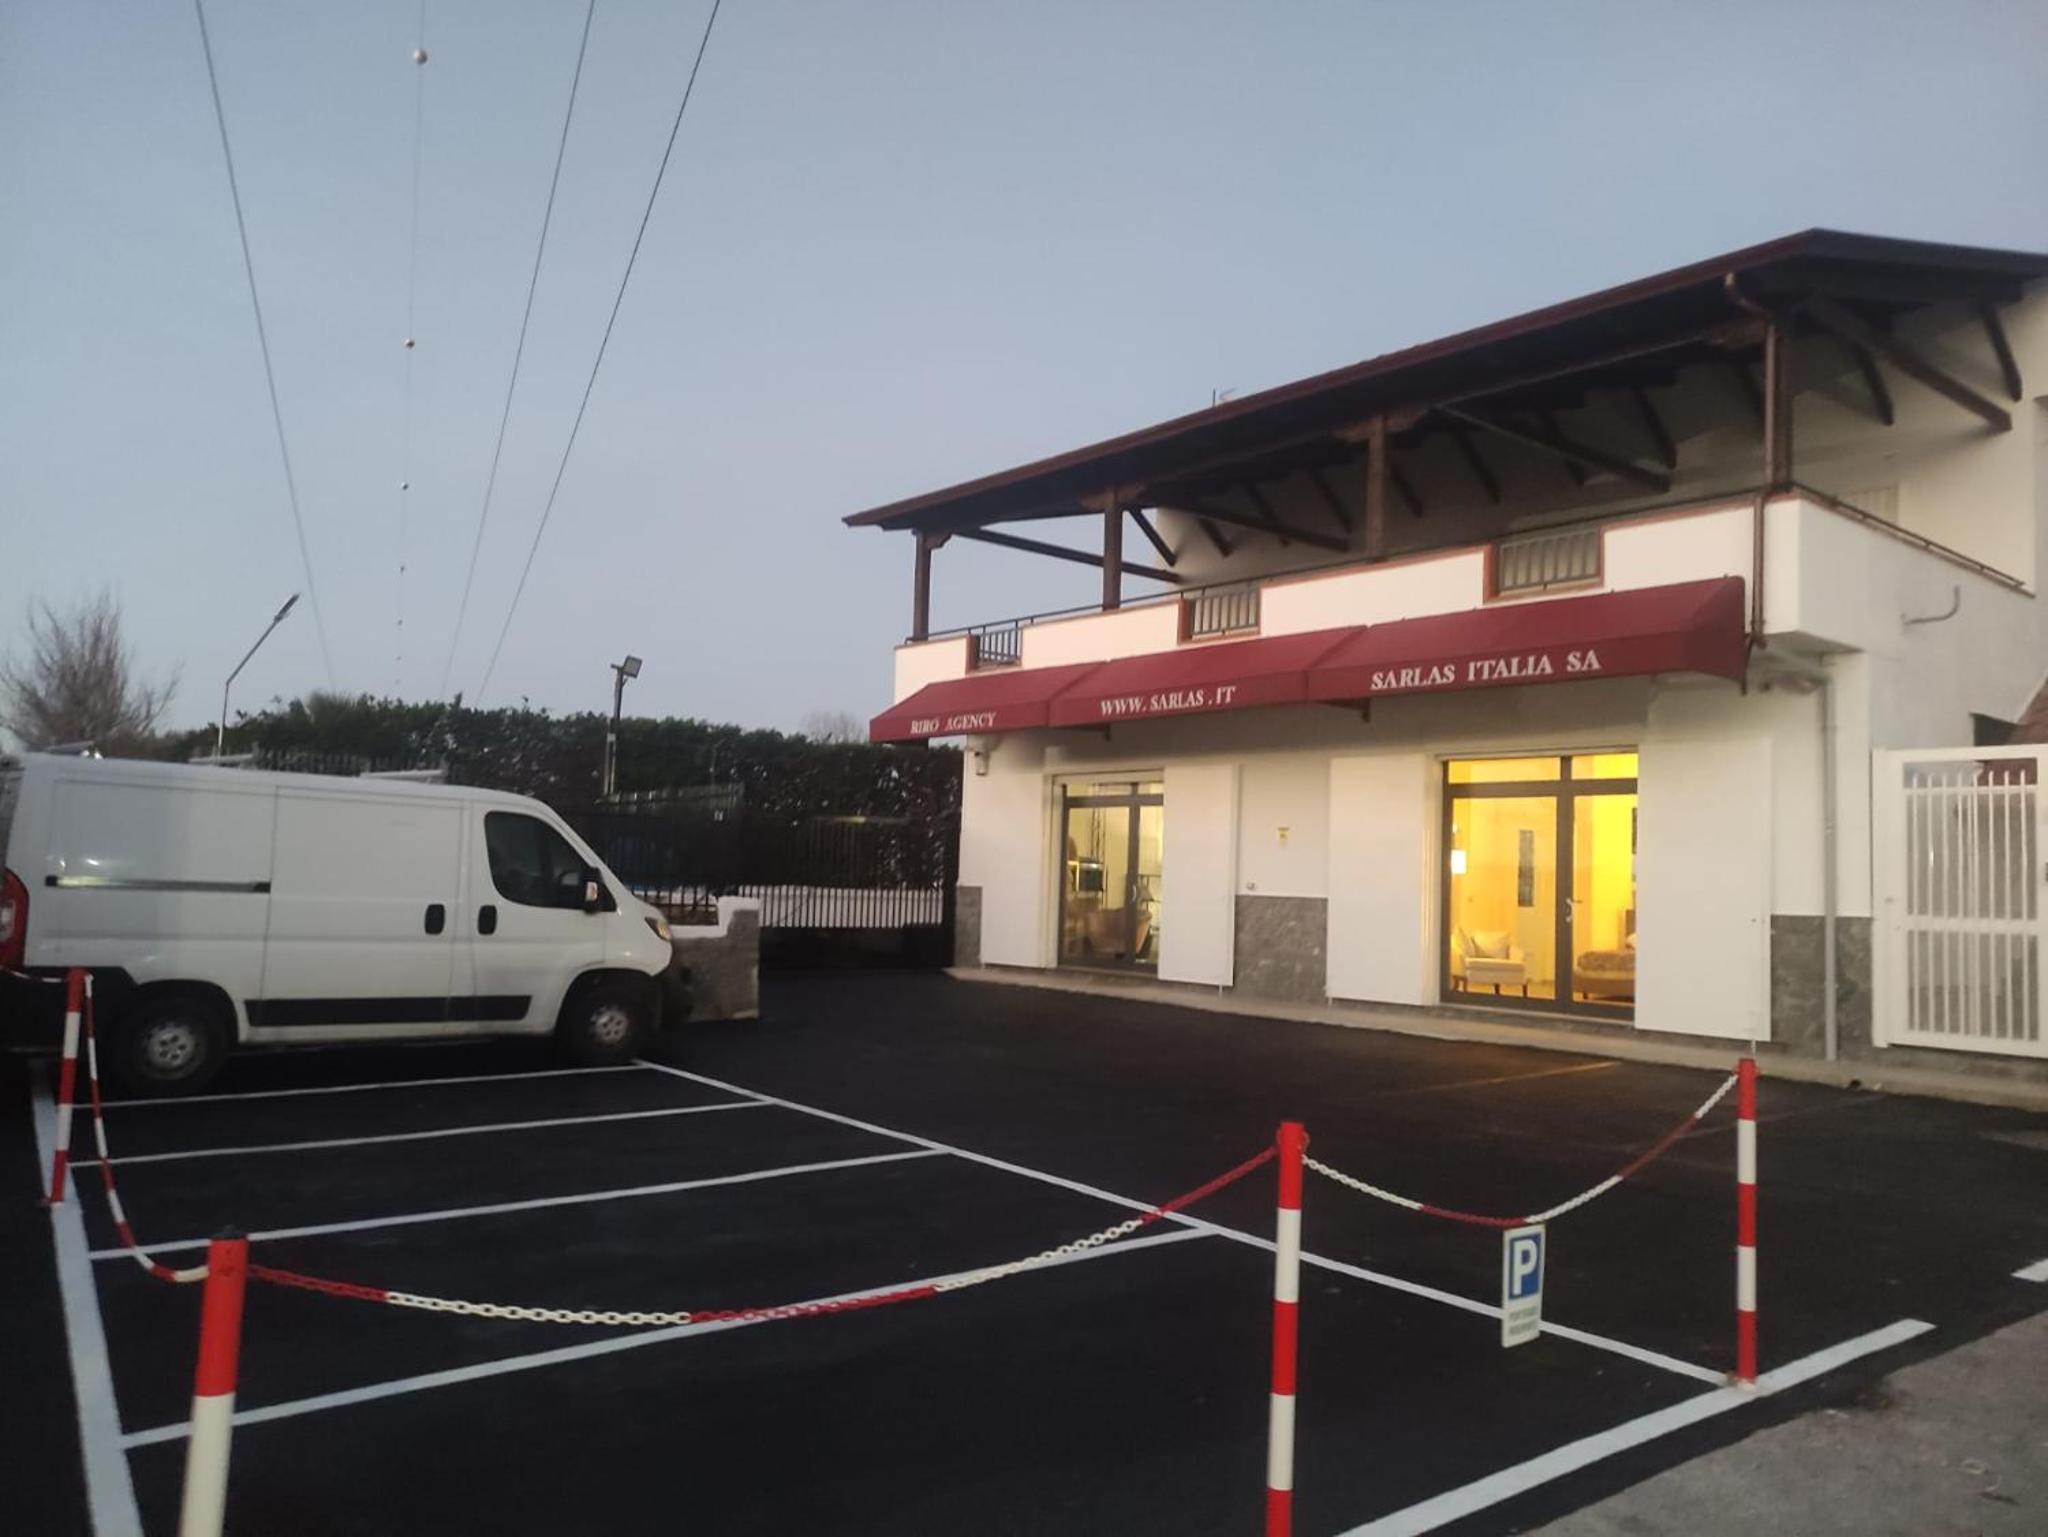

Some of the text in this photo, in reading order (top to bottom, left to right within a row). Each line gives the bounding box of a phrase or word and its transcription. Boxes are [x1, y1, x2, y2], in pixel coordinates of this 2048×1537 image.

[1370, 649, 1601, 690] SARLAS ITALIA SA
[944, 711, 996, 731] AGENCY
[1513, 1239, 1537, 1295] P
